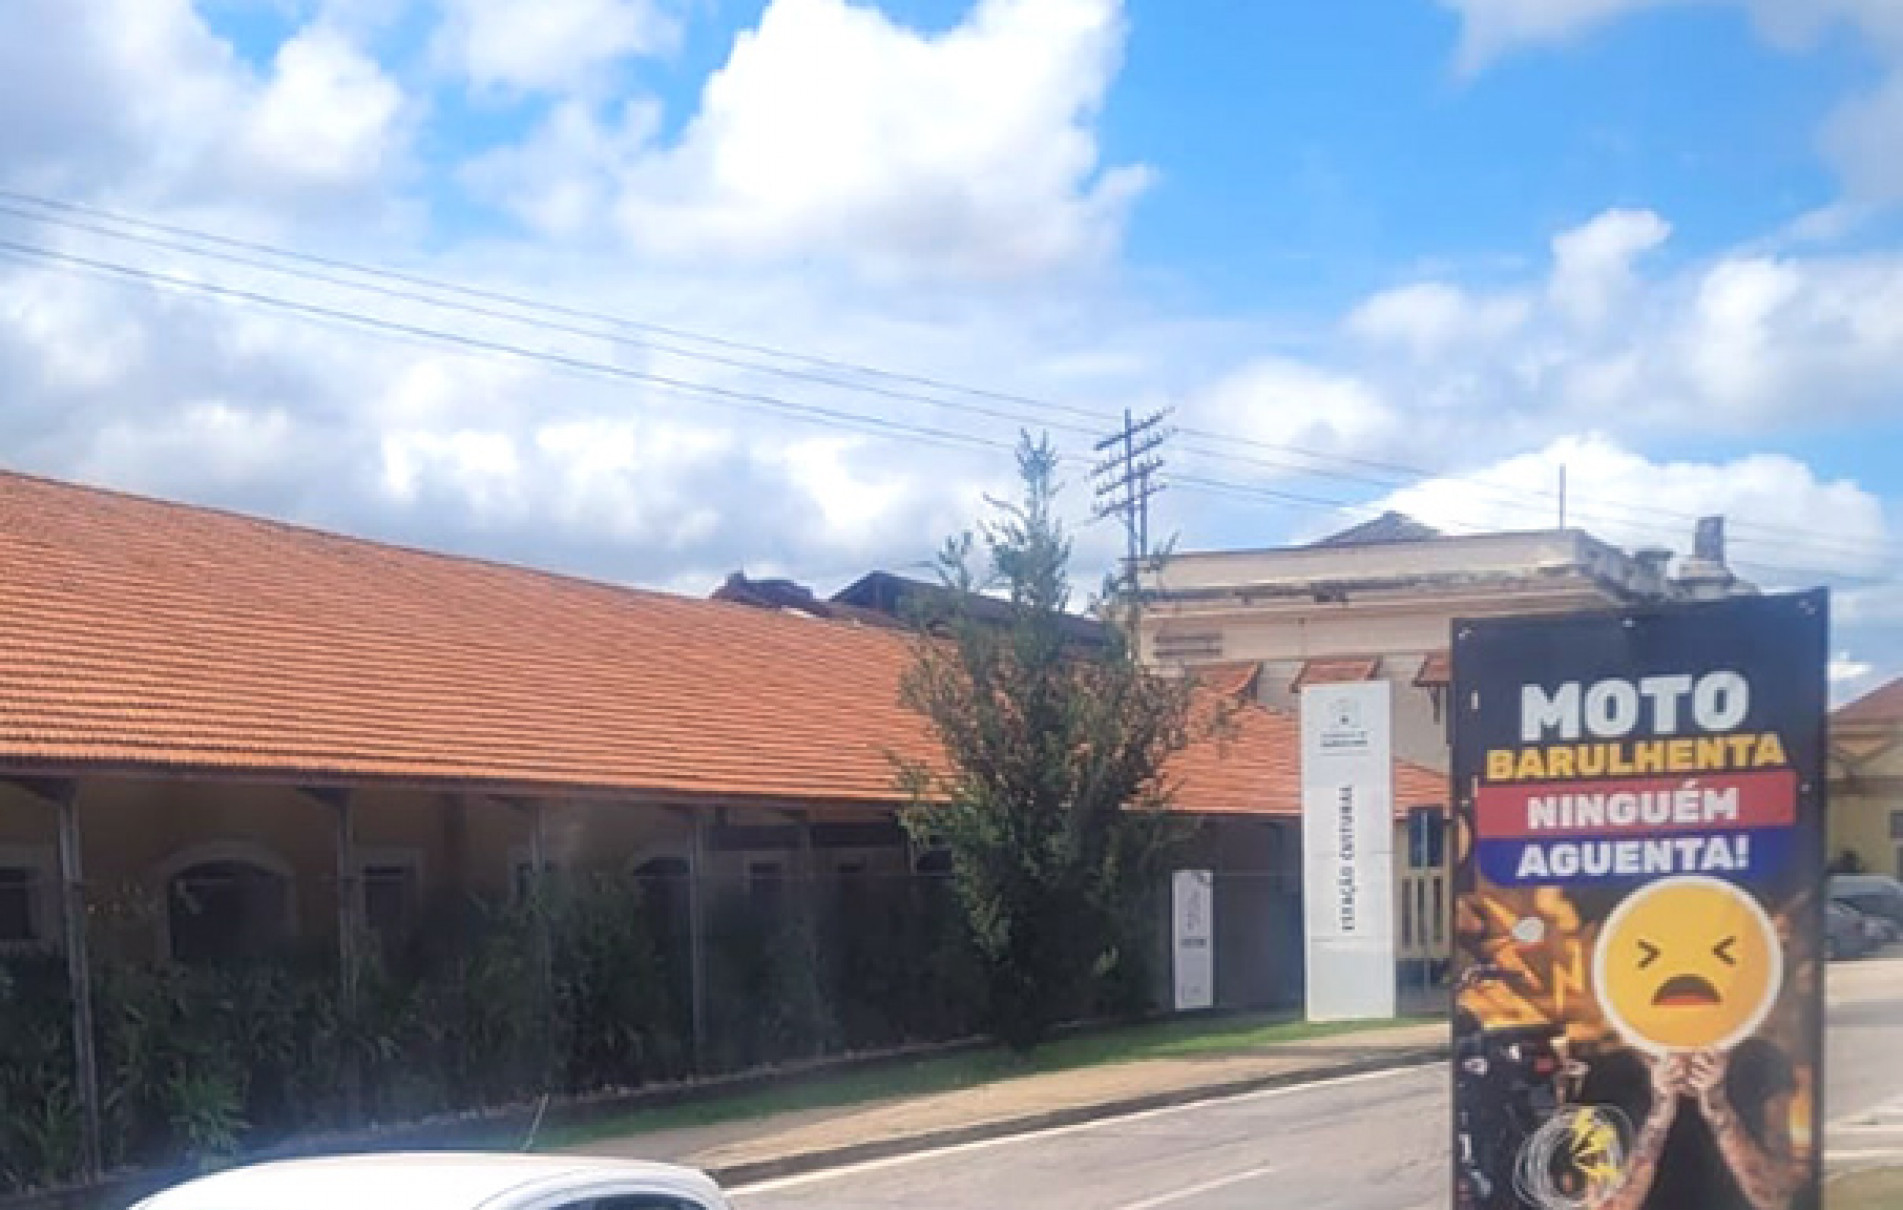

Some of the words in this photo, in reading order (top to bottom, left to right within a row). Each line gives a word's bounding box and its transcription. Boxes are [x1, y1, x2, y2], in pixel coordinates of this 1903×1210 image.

[1521, 670, 1749, 742] MOTO
[1486, 731, 1787, 782] BARULHENTA
[1527, 778, 1739, 829] NINGUÉM
[1515, 835, 1750, 879] AGUENTA!
